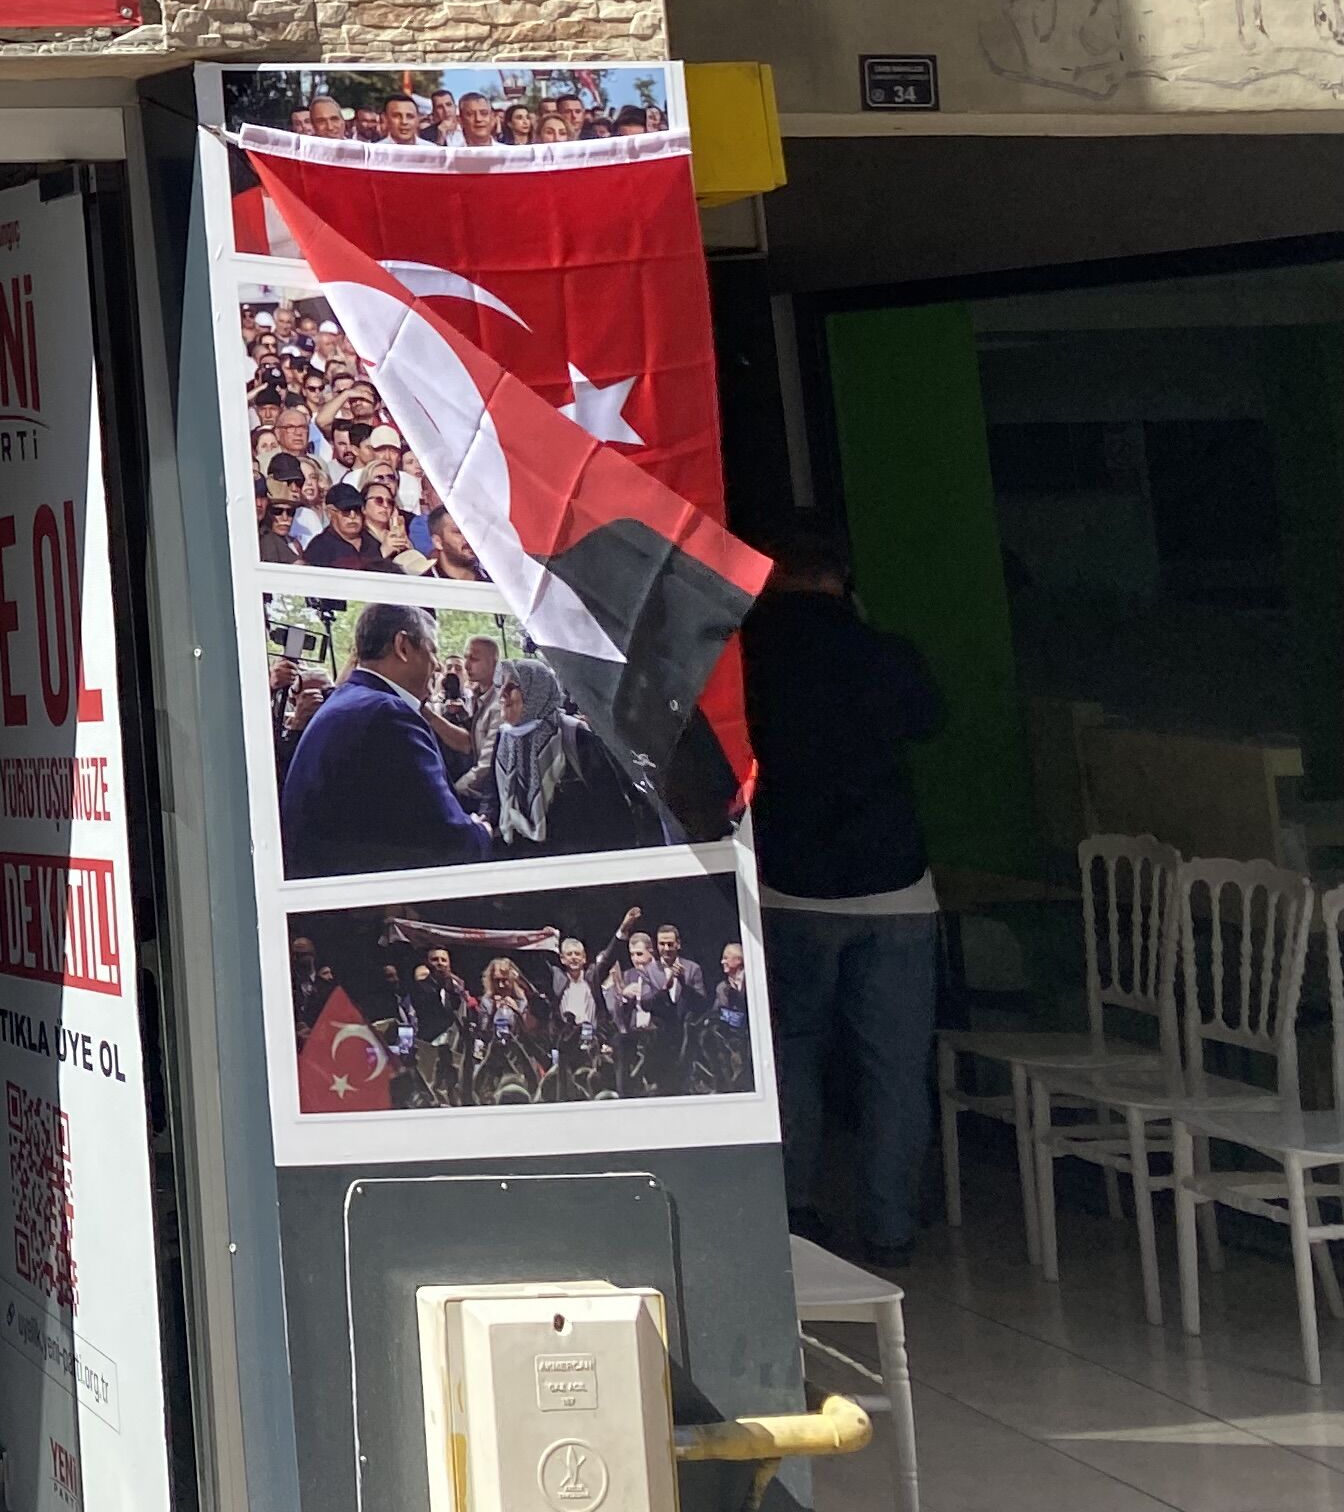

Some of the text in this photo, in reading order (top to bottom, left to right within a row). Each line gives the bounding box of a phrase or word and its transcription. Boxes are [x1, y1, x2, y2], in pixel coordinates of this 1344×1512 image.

[893, 85, 916, 103] 34
[32, 500, 104, 728] OL
[4, 864, 36, 969] DE
[37, 868, 119, 986] KATIL!
[55, 1018, 94, 1072] ÜYE
[99, 1039, 127, 1083] OL
